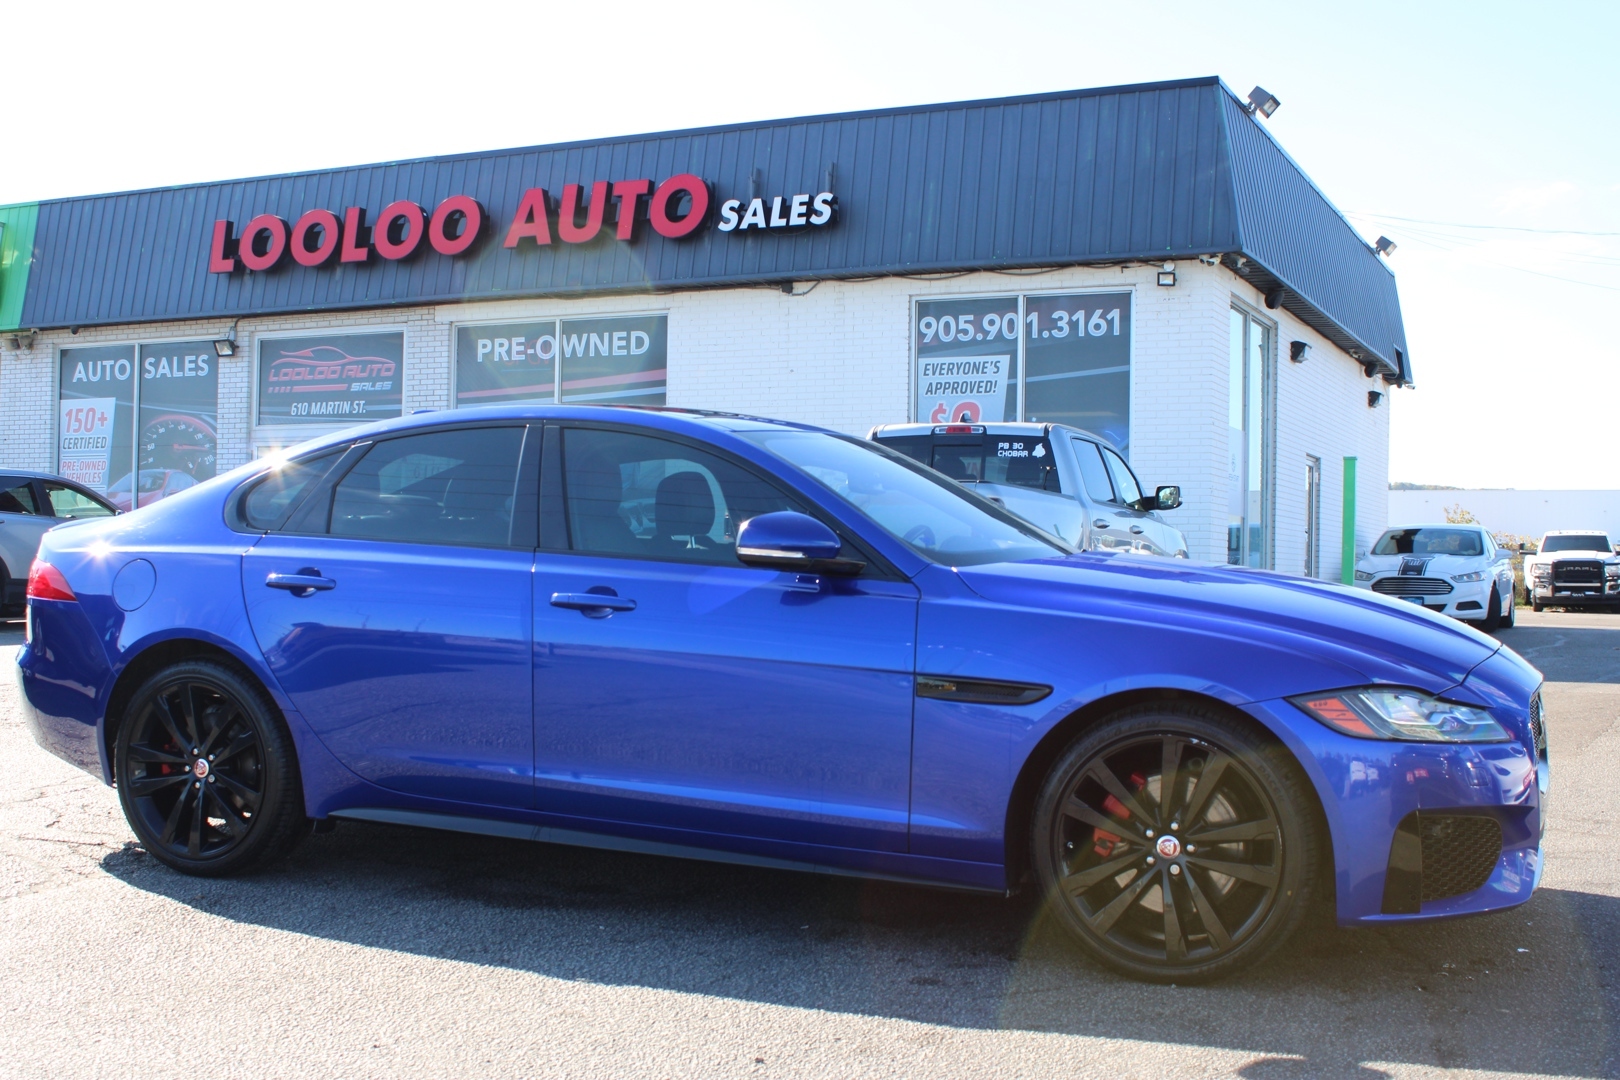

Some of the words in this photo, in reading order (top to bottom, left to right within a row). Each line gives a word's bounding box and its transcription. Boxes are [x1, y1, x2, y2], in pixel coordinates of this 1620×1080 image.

[209, 195, 482, 273] LOOLOO
[503, 173, 710, 248] AUTO
[717, 191, 835, 232] SALES
[919, 308, 1121, 343] 905.901.3161
[477, 330, 650, 362] PRE-OWNED
[72, 359, 131, 383] AUTO
[144, 354, 209, 379] SALES
[268, 366, 341, 382] LOOLOO
[342, 363, 396, 378] AUTO
[923, 360, 1001, 377] EVERYONE'S
[350, 381, 393, 392] SALES
[925, 380, 998, 396] APPROVED!
[290, 402, 308, 416] 610
[310, 400, 351, 416] MARTIN
[352, 400, 367, 414] ST.
[65, 407, 108, 434] 150+
[62, 436, 107, 450] CERTIFIED
[1012, 442, 1024, 450] 30
[997, 450, 1029, 458] CHOBAR
[61, 460, 107, 472] PRE-OWNED
[66, 472, 102, 484] VEHICLES
